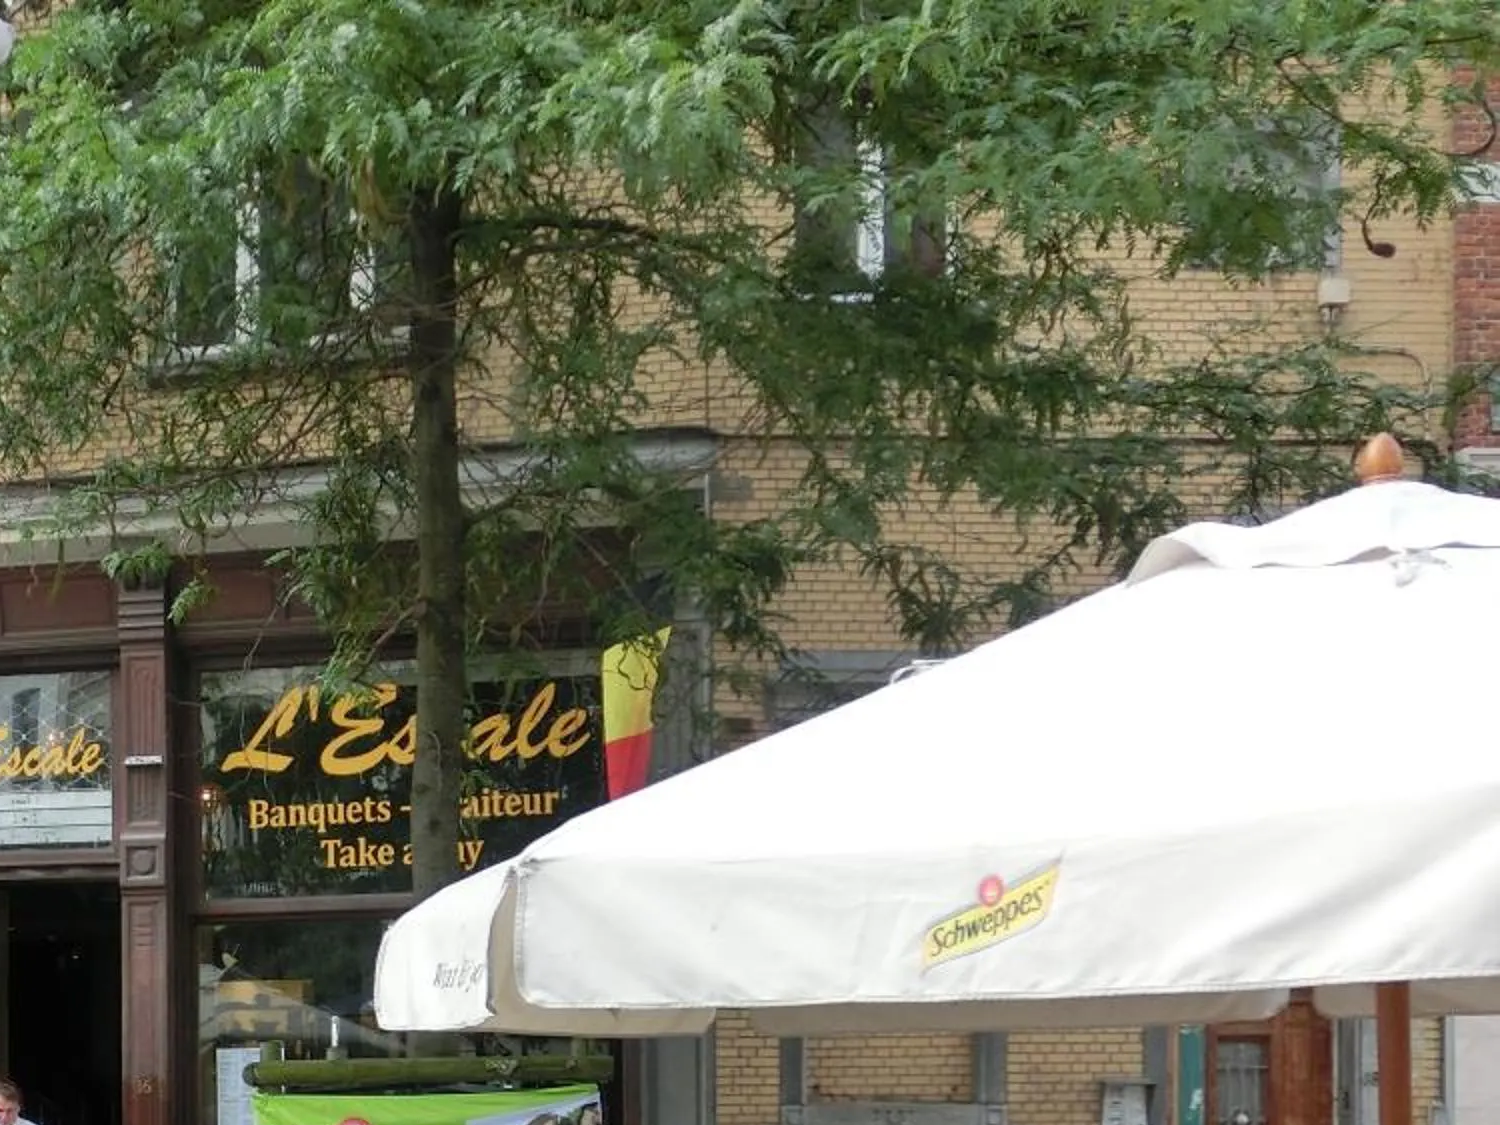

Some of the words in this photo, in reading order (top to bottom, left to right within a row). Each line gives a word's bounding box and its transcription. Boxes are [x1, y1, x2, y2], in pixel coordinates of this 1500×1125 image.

[220, 682, 591, 776] L'Esale
[249, 799, 392, 833] Banquets
[460, 788, 559, 818] aiteur
[320, 837, 395, 868] Take
[402, 840, 485, 871] ay
[930, 885, 1045, 957] Schweppes
